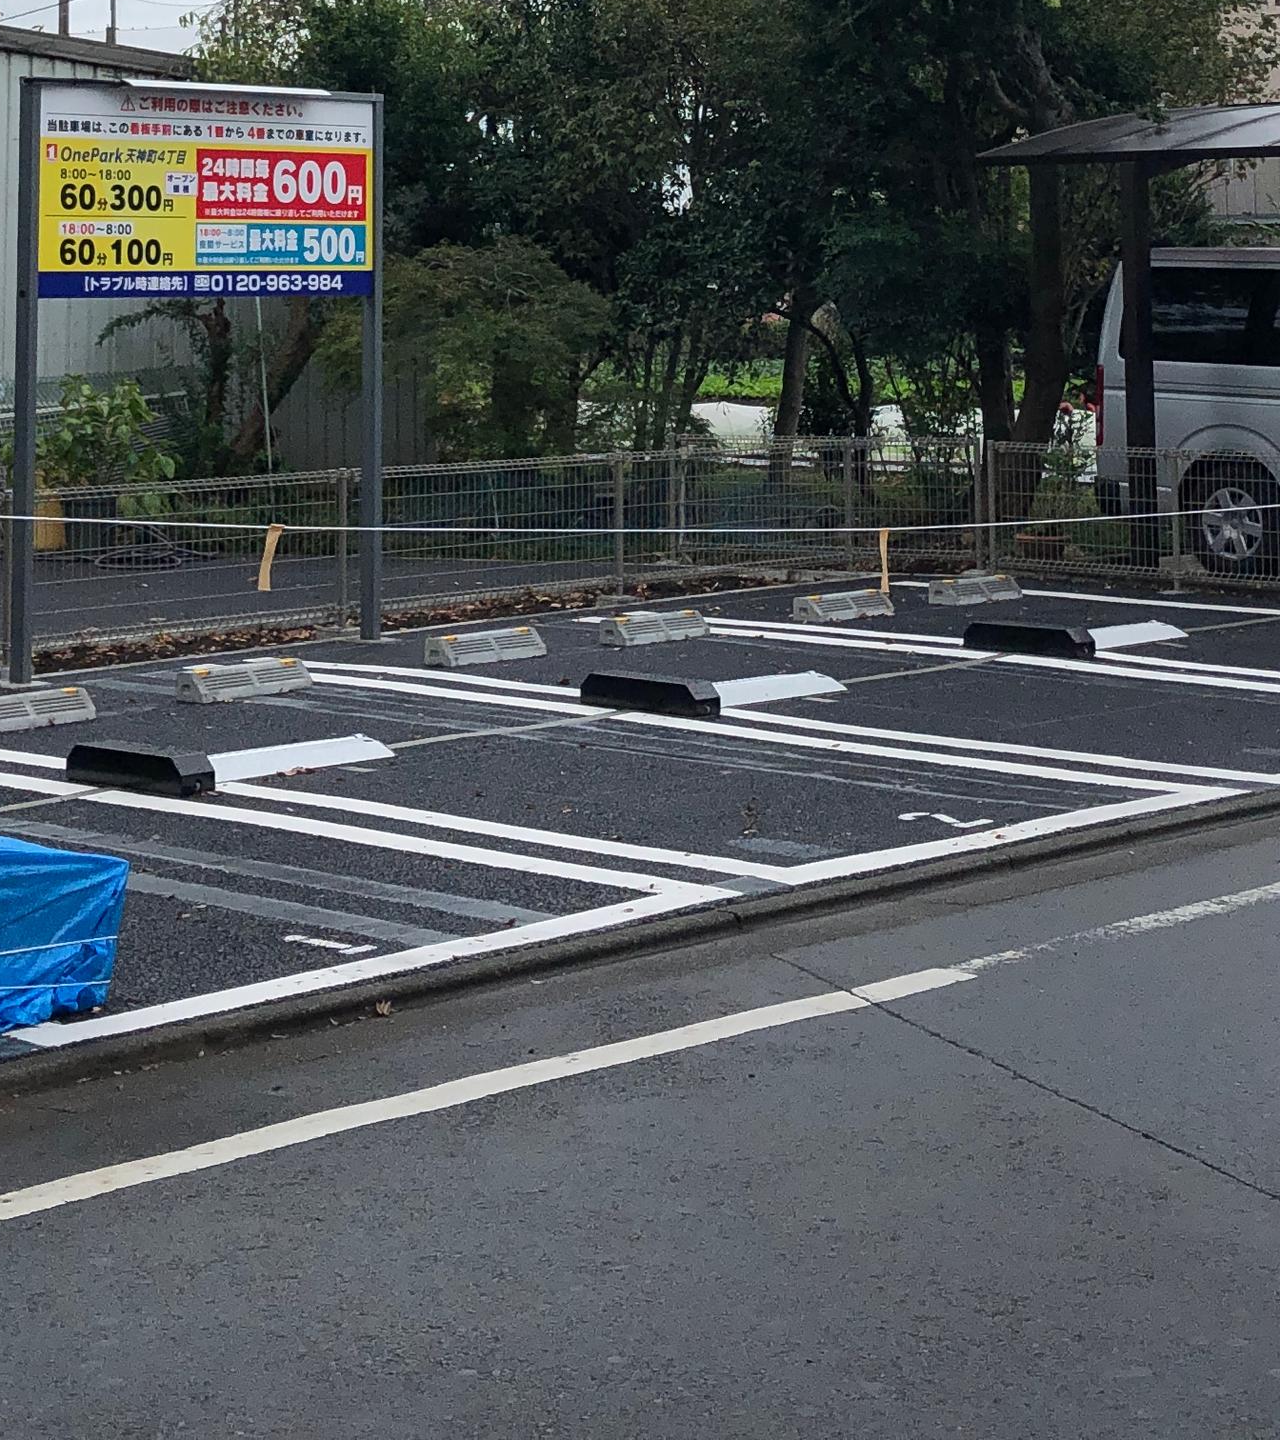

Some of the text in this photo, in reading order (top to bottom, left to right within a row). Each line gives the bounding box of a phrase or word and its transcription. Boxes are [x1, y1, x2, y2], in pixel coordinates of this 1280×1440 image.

[61, 146, 124, 163] OnePark
[124, 148, 187, 165] 天神町4丁目
[167, 174, 196, 183] オープン
[273, 159, 363, 205] 600円
[202, 182, 269, 203] 最大料金
[249, 228, 298, 252] 最大料金
[211, 274, 343, 292] 0120-963-984
